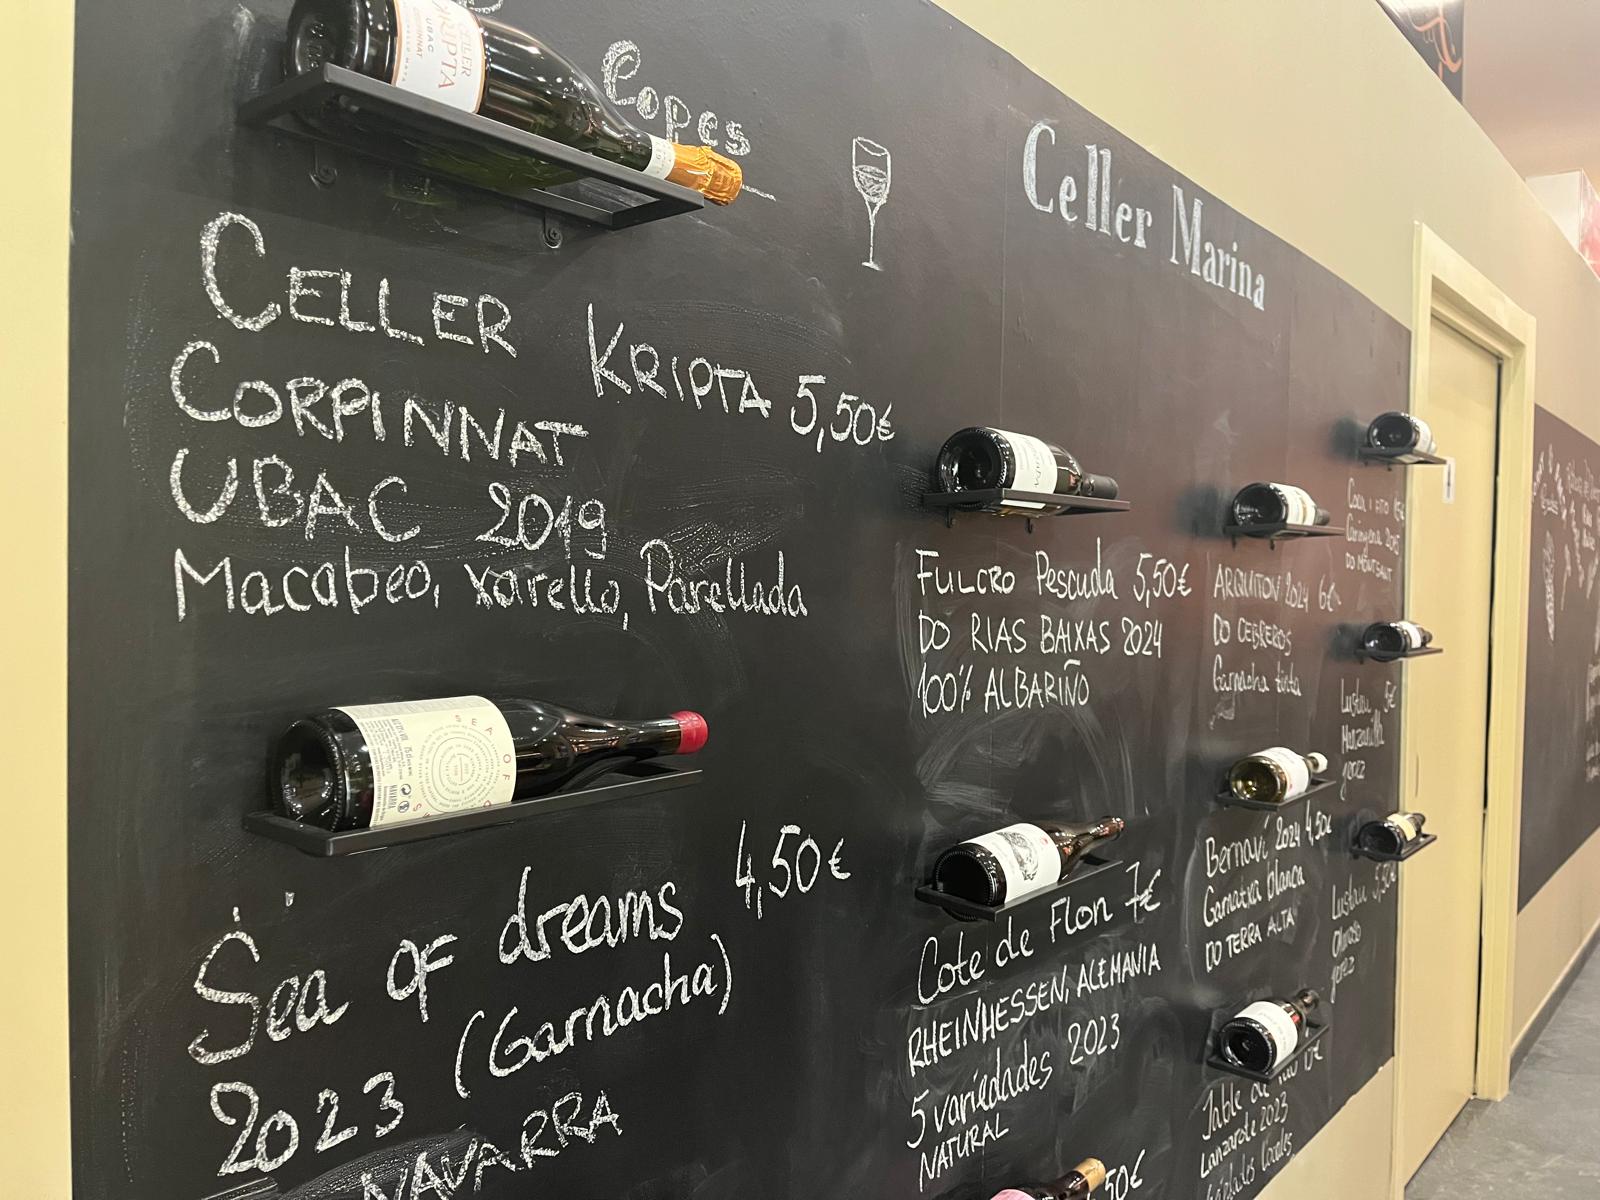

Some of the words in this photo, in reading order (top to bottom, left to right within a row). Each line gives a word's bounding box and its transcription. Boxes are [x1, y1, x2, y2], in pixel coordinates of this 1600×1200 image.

[425, 17, 434, 52] UBAC
[601, 40, 751, 156] Copes
[1023, 120, 1153, 249] Celler
[1169, 184, 1265, 312] Marina
[200, 212, 518, 359] CELLER
[587, 302, 772, 419] KRIPTA
[789, 374, 895, 453] 5,50€
[170, 340, 589, 468] CORPINNAT
[169, 448, 421, 543] UBAC
[475, 481, 607, 561] 2019
[174, 545, 440, 622] Macabeo,
[639, 538, 808, 618] Parellada
[1035, 536, 1119, 601] Pescuda
[1133, 552, 1193, 609] 5,50€
[1285, 571, 1309, 613] 2024
[918, 609, 951, 655] DO
[971, 612, 1028, 654] RIAS
[1040, 614, 1111, 655] BAIXAS
[1121, 616, 1163, 659] 2024
[1213, 613, 1231, 646] DO
[917, 661, 974, 719] 100%
[984, 658, 1090, 714] ALBARIÑO
[1205, 814, 1271, 878] Bernaví
[1275, 816, 1301, 851] 2024
[1266, 858, 1306, 902] blanca
[188, 930, 349, 1066] Sea
[498, 866, 684, 965] dreams
[734, 820, 852, 920] 4,50€
[917, 931, 985, 1005] Cote
[995, 915, 1034, 968] de
[1124, 861, 1162, 923] 7€
[1076, 942, 1162, 998] ALEMANIA
[1205, 940, 1223, 974] DO
[1226, 922, 1263, 959] TERRA
[1266, 907, 1296, 937] ALTA
[210, 1071, 405, 1177] 2023
[455, 933, 733, 1100] (Garnacha)
[907, 1088, 930, 1149] 5
[933, 1038, 1053, 1134] variedades
[1067, 1013, 1121, 1065] 2023
[361, 1090, 623, 1200] NAVARRA
[1259, 1091, 1289, 1132] 2023
[919, 1113, 1010, 1193] NATURAL
